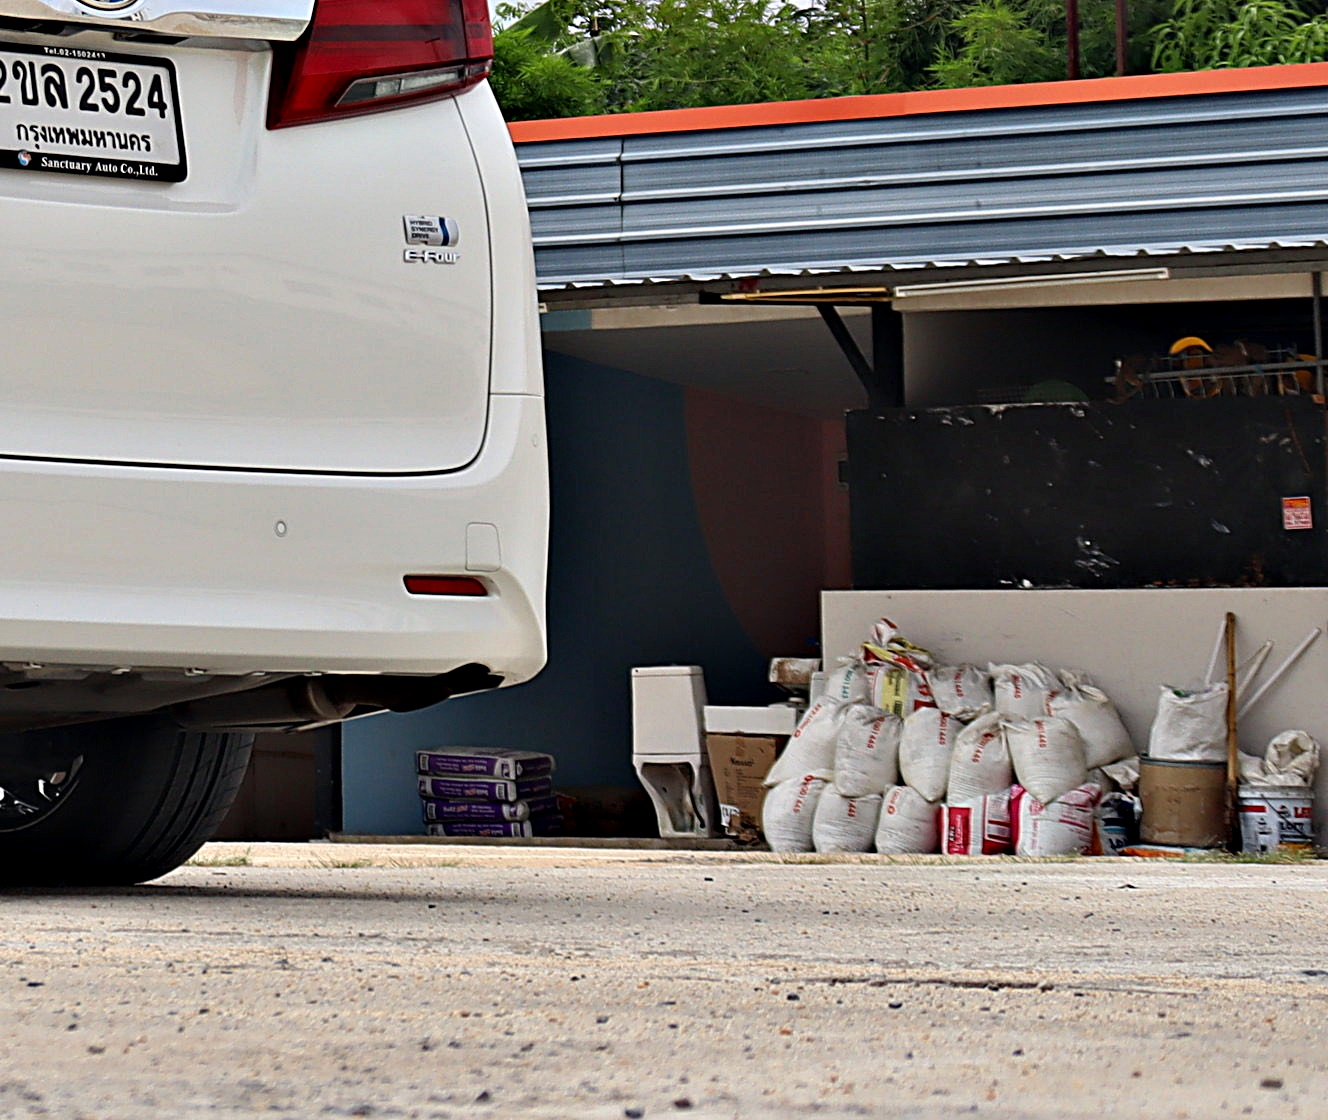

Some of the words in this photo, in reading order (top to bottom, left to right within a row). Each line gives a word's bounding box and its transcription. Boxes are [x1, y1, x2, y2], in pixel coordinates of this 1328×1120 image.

[75, 66, 168, 119] 2524
[16, 123, 152, 152] กรุงเทพมหานคร
[41, 156, 92, 173] Sanctuary
[95, 161, 118, 173] Auto
[403, 249, 460, 264] E-Four
